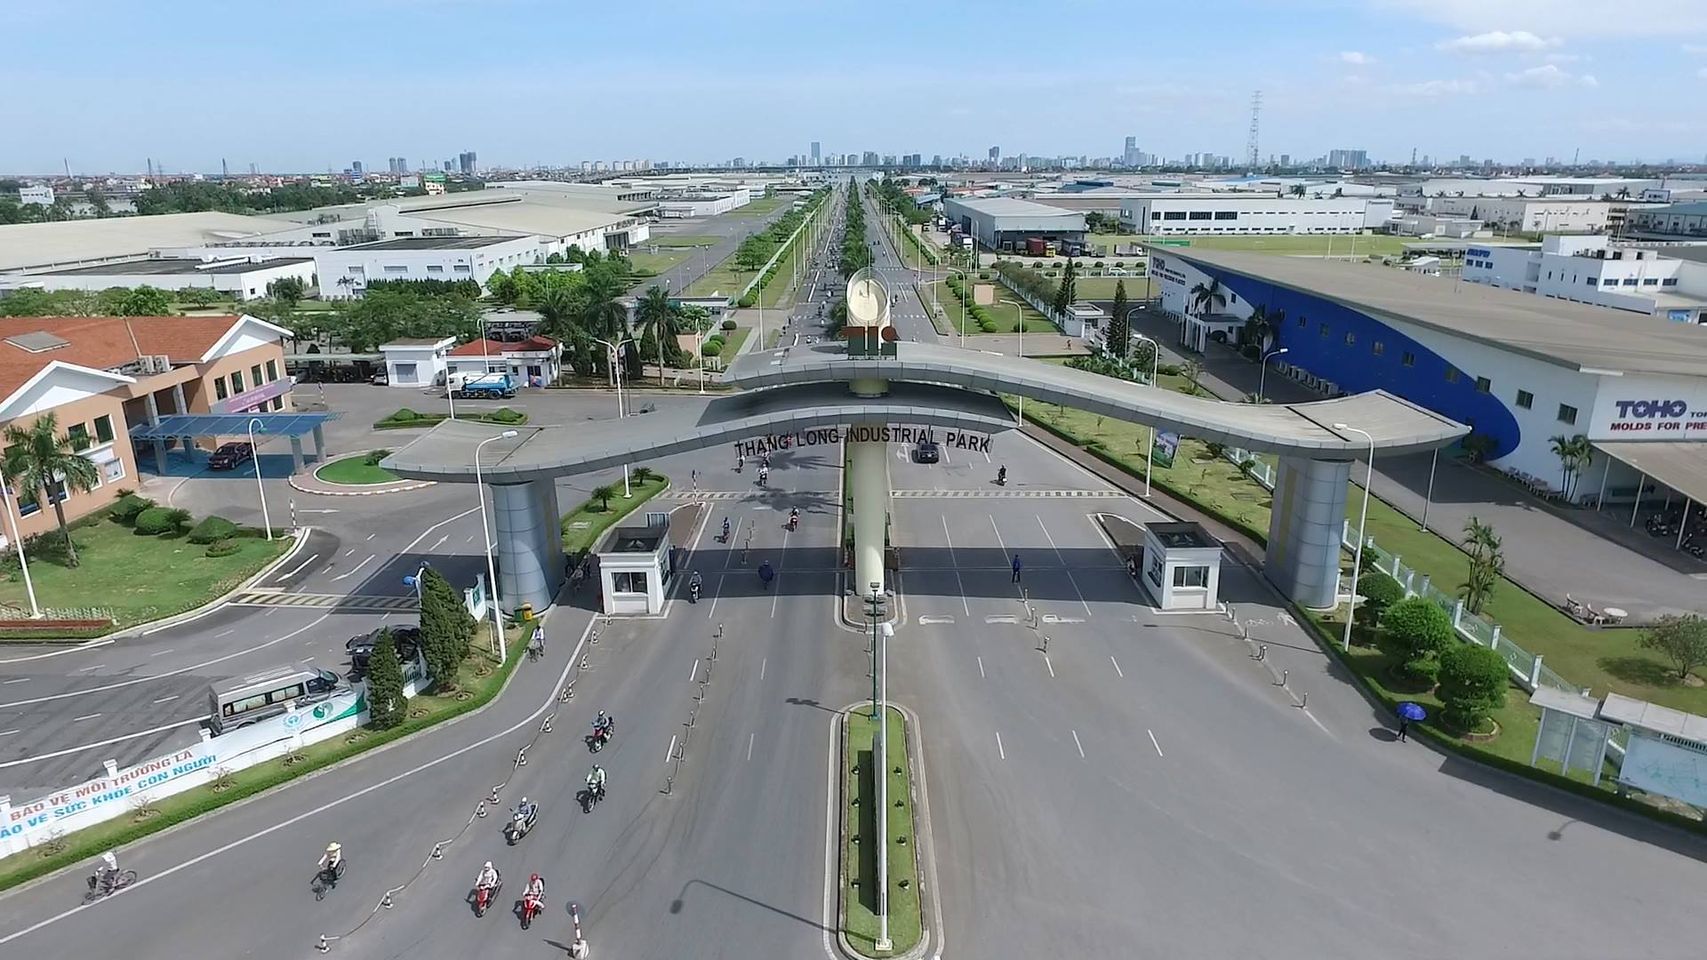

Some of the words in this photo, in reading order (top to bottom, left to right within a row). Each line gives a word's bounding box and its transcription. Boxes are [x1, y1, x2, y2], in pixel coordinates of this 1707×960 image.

[1615, 400, 1688, 419] TOHO
[1610, 422, 1652, 431] MOLDS
[1657, 421, 1681, 431] FOR
[734, 435, 789, 457] THANG
[796, 428, 840, 447] LONG
[845, 426, 940, 444] INDUSTRIAL
[946, 432, 990, 454] PARK
[138, 771, 169, 789] CON
